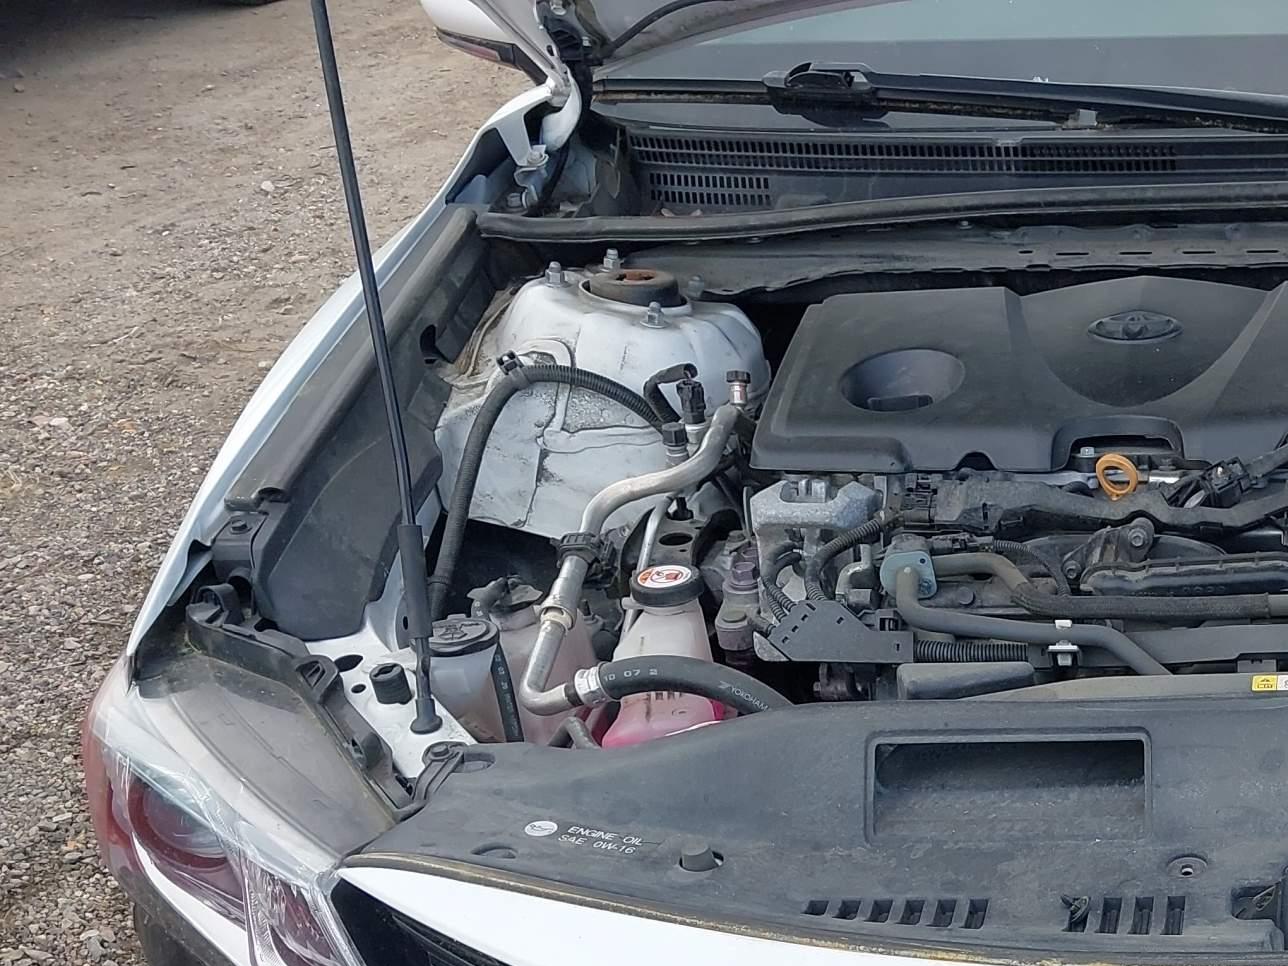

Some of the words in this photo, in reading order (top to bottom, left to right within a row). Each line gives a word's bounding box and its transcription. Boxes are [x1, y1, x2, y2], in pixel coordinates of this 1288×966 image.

[623, 669, 641, 677] 07
[731, 686, 768, 711] YOKOHAM
[558, 834, 587, 845] SAE
[592, 841, 636, 854] 0W-16
[568, 826, 618, 841] ENGINE
[623, 836, 642, 846] OIL
